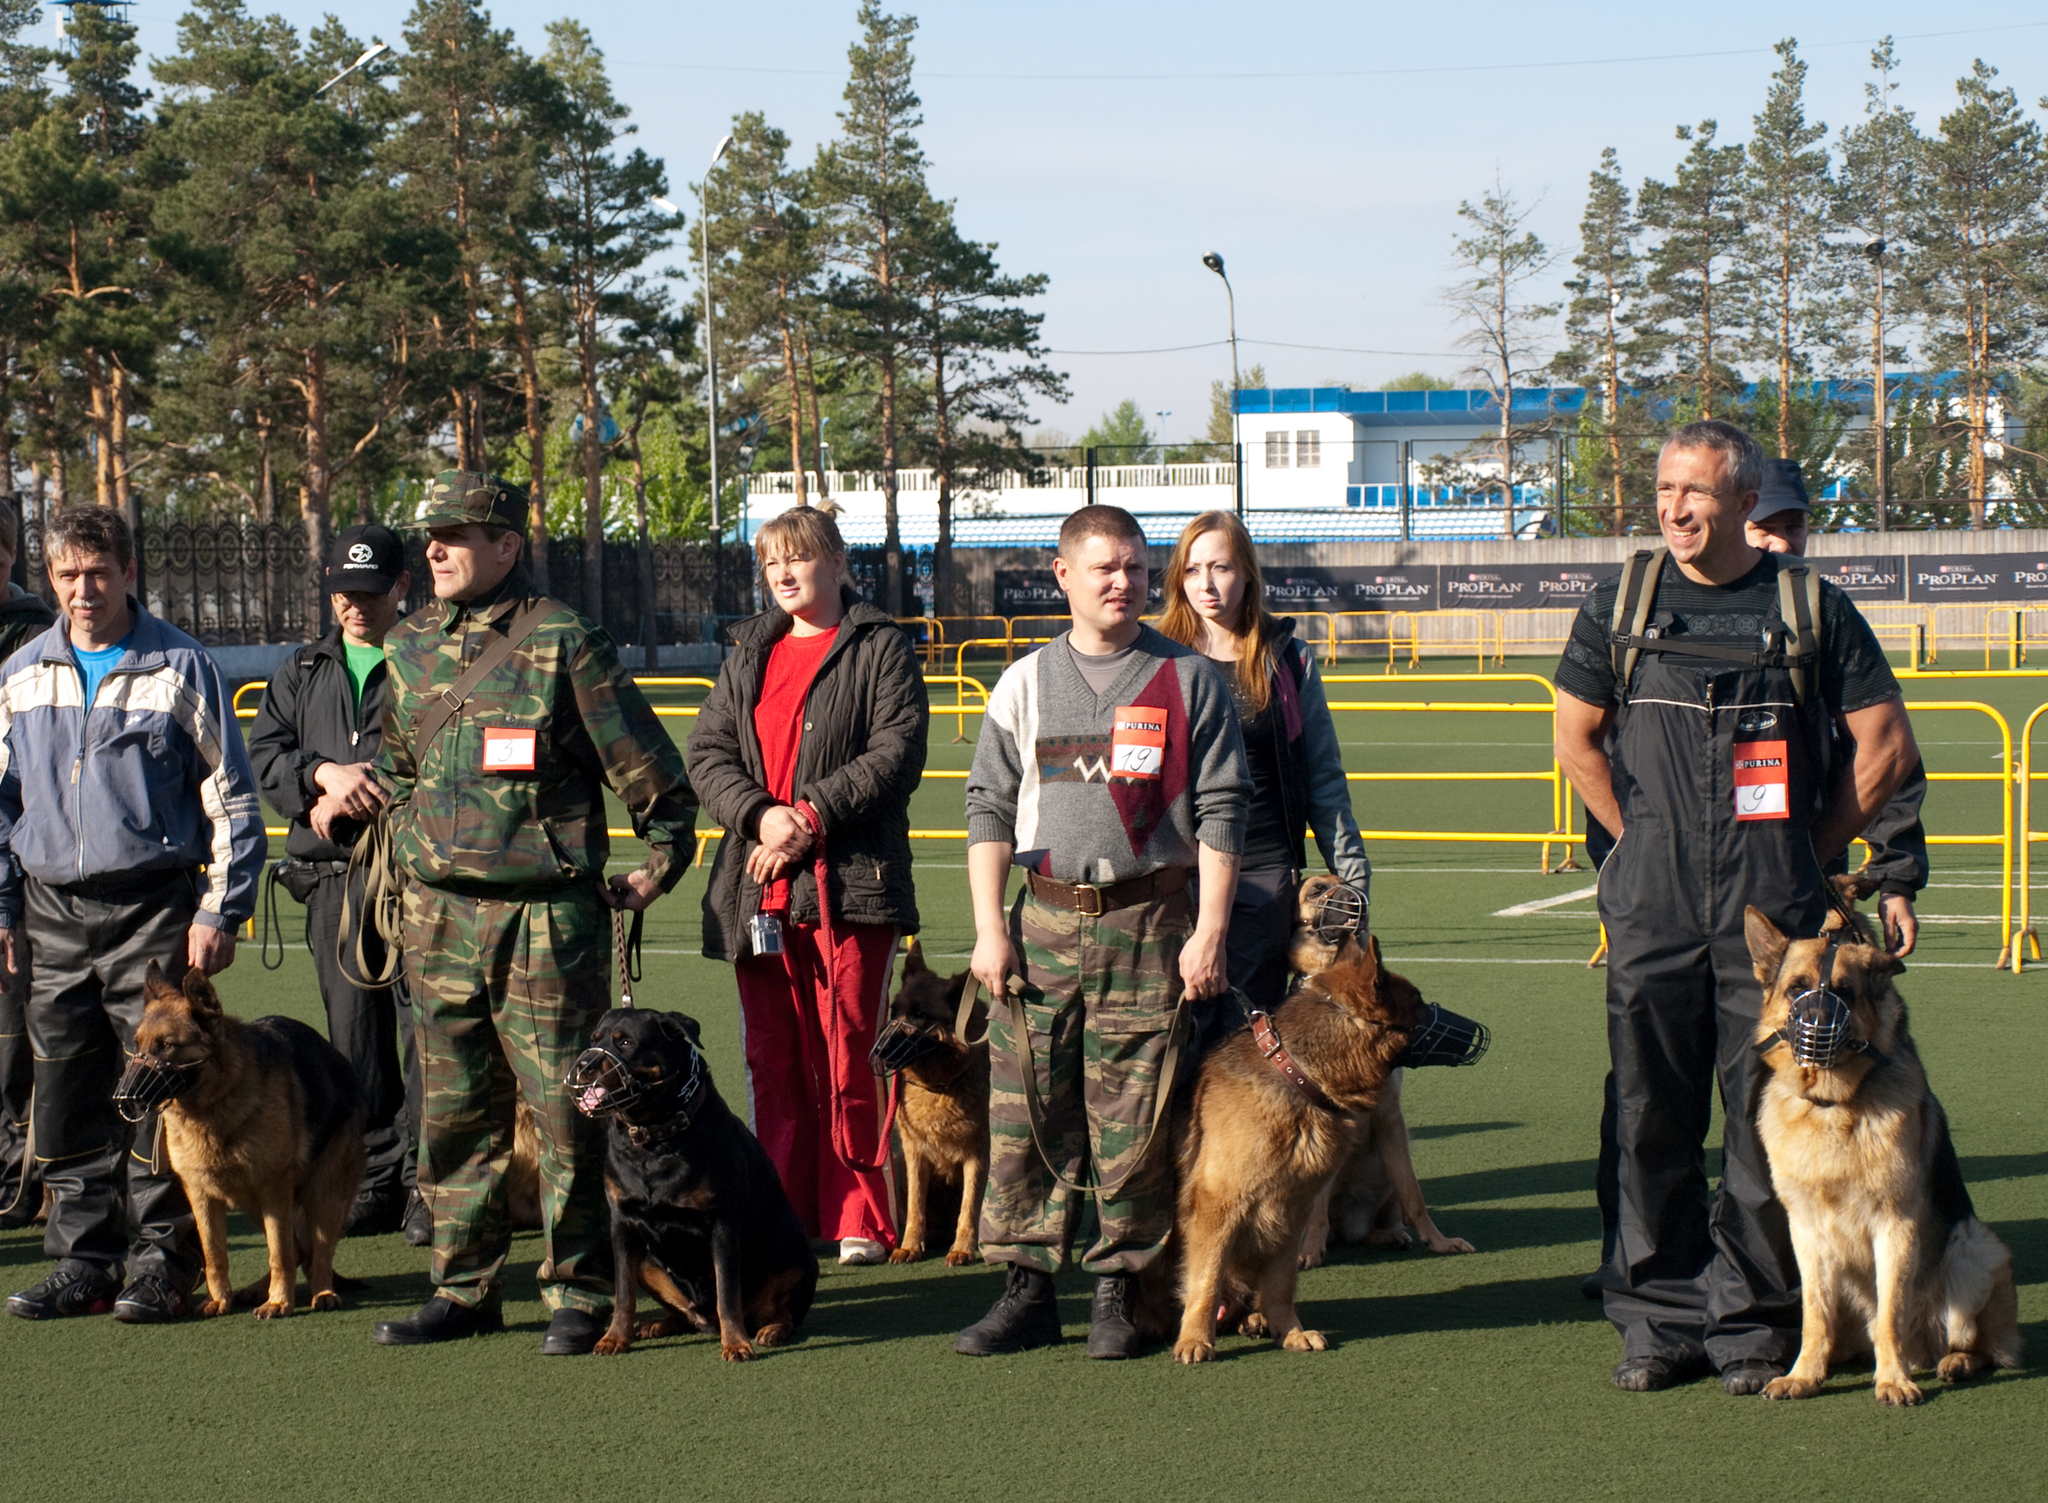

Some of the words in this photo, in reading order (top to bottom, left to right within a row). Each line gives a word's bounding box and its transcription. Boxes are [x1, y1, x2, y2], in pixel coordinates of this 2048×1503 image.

[1125, 722, 1161, 732] PURINA
[497, 739, 513, 762] 3
[1120, 747, 1152, 771] 19
[1744, 758, 1781, 768] PURINA
[1743, 784, 1767, 812] 9
